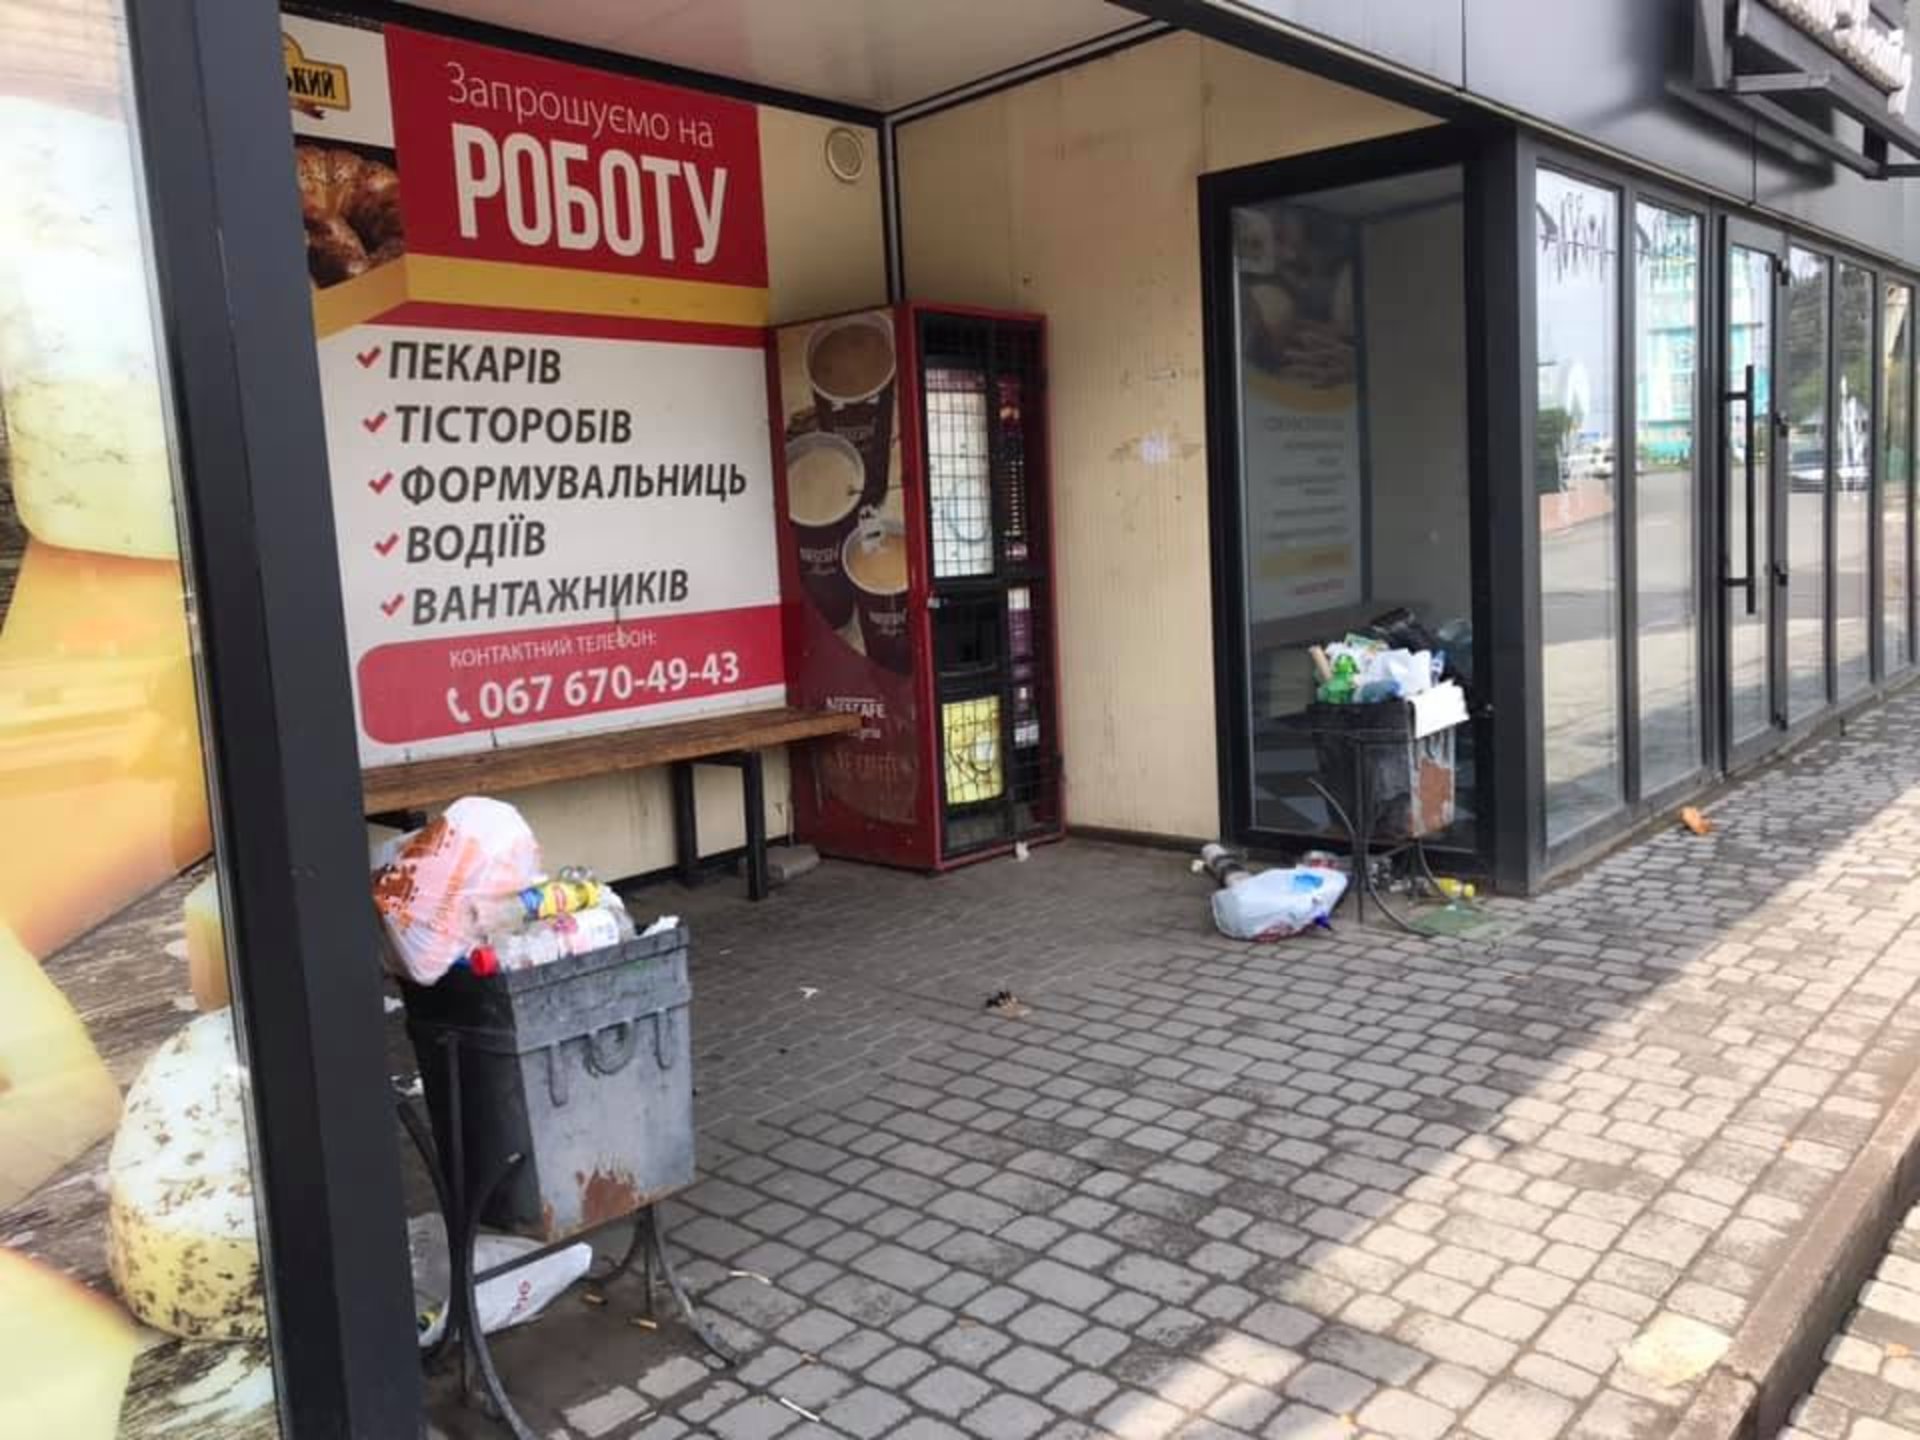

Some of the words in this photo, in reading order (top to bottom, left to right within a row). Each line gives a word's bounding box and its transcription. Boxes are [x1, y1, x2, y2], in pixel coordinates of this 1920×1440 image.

[447, 61, 670, 142] Запрошуємо
[679, 117, 713, 148] на
[452, 122, 727, 265] РОБОТУ
[388, 342, 562, 384] ПЕКАРІВ
[395, 405, 632, 444] ТІСТОРОБІВ
[400, 462, 747, 506] ФОРМУВАЛЬНИЦЬ
[406, 513, 546, 567] ВОДІЇВ
[412, 568, 690, 626] ВАНТАЖНИКІВ
[449, 637, 574, 669] КОНТАКТНИЙ
[576, 628, 658, 657] ТЕЛЕФОН:
[479, 673, 554, 719] 067
[563, 650, 741, 707] 670-49-43
